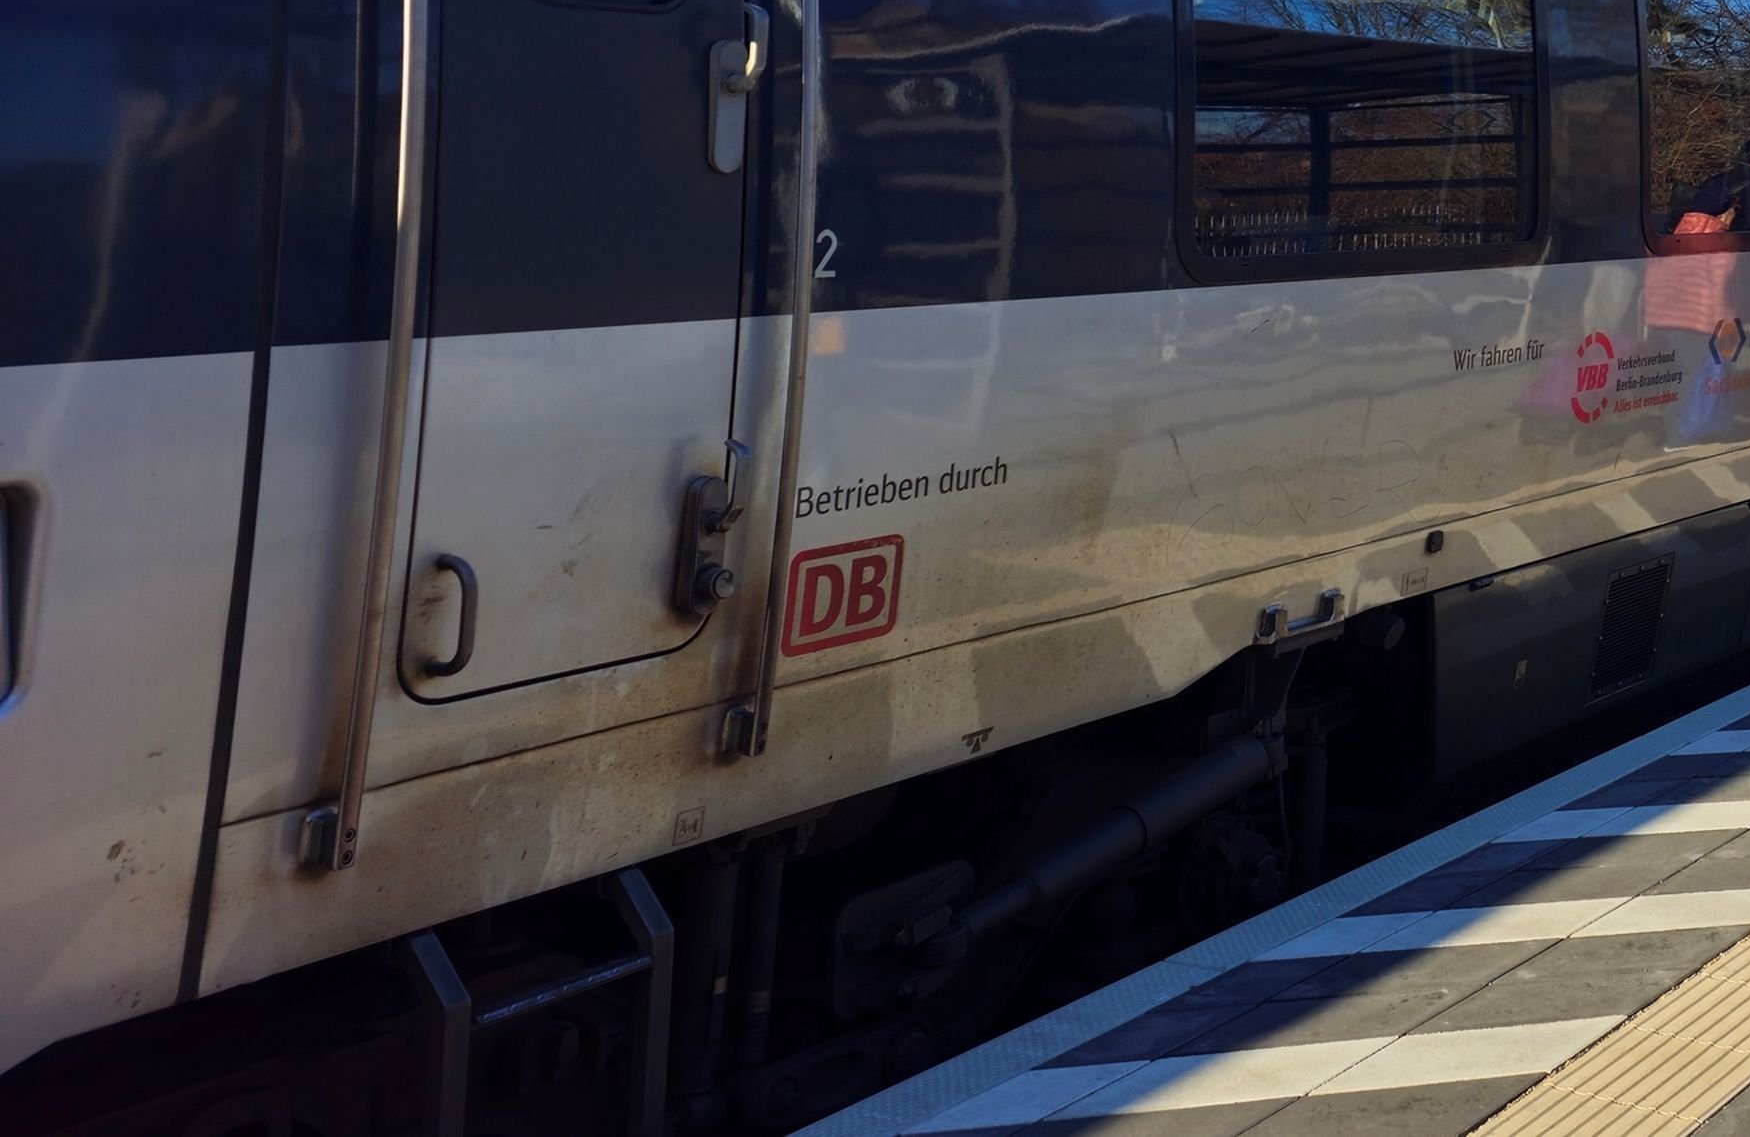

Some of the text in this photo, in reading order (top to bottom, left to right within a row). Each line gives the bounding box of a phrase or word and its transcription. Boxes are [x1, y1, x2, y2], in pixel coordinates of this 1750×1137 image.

[814, 228, 838, 279] 2
[1454, 339, 1545, 371] Wir fahren für
[1617, 349, 1676, 371] Verkehrsverbund
[1577, 363, 1609, 393] VBB
[1615, 370, 1683, 392] Berlin-Brandenburg
[1613, 398, 1632, 414] Alles
[795, 456, 1008, 518] Betrieben durch
[798, 554, 888, 638] DB
